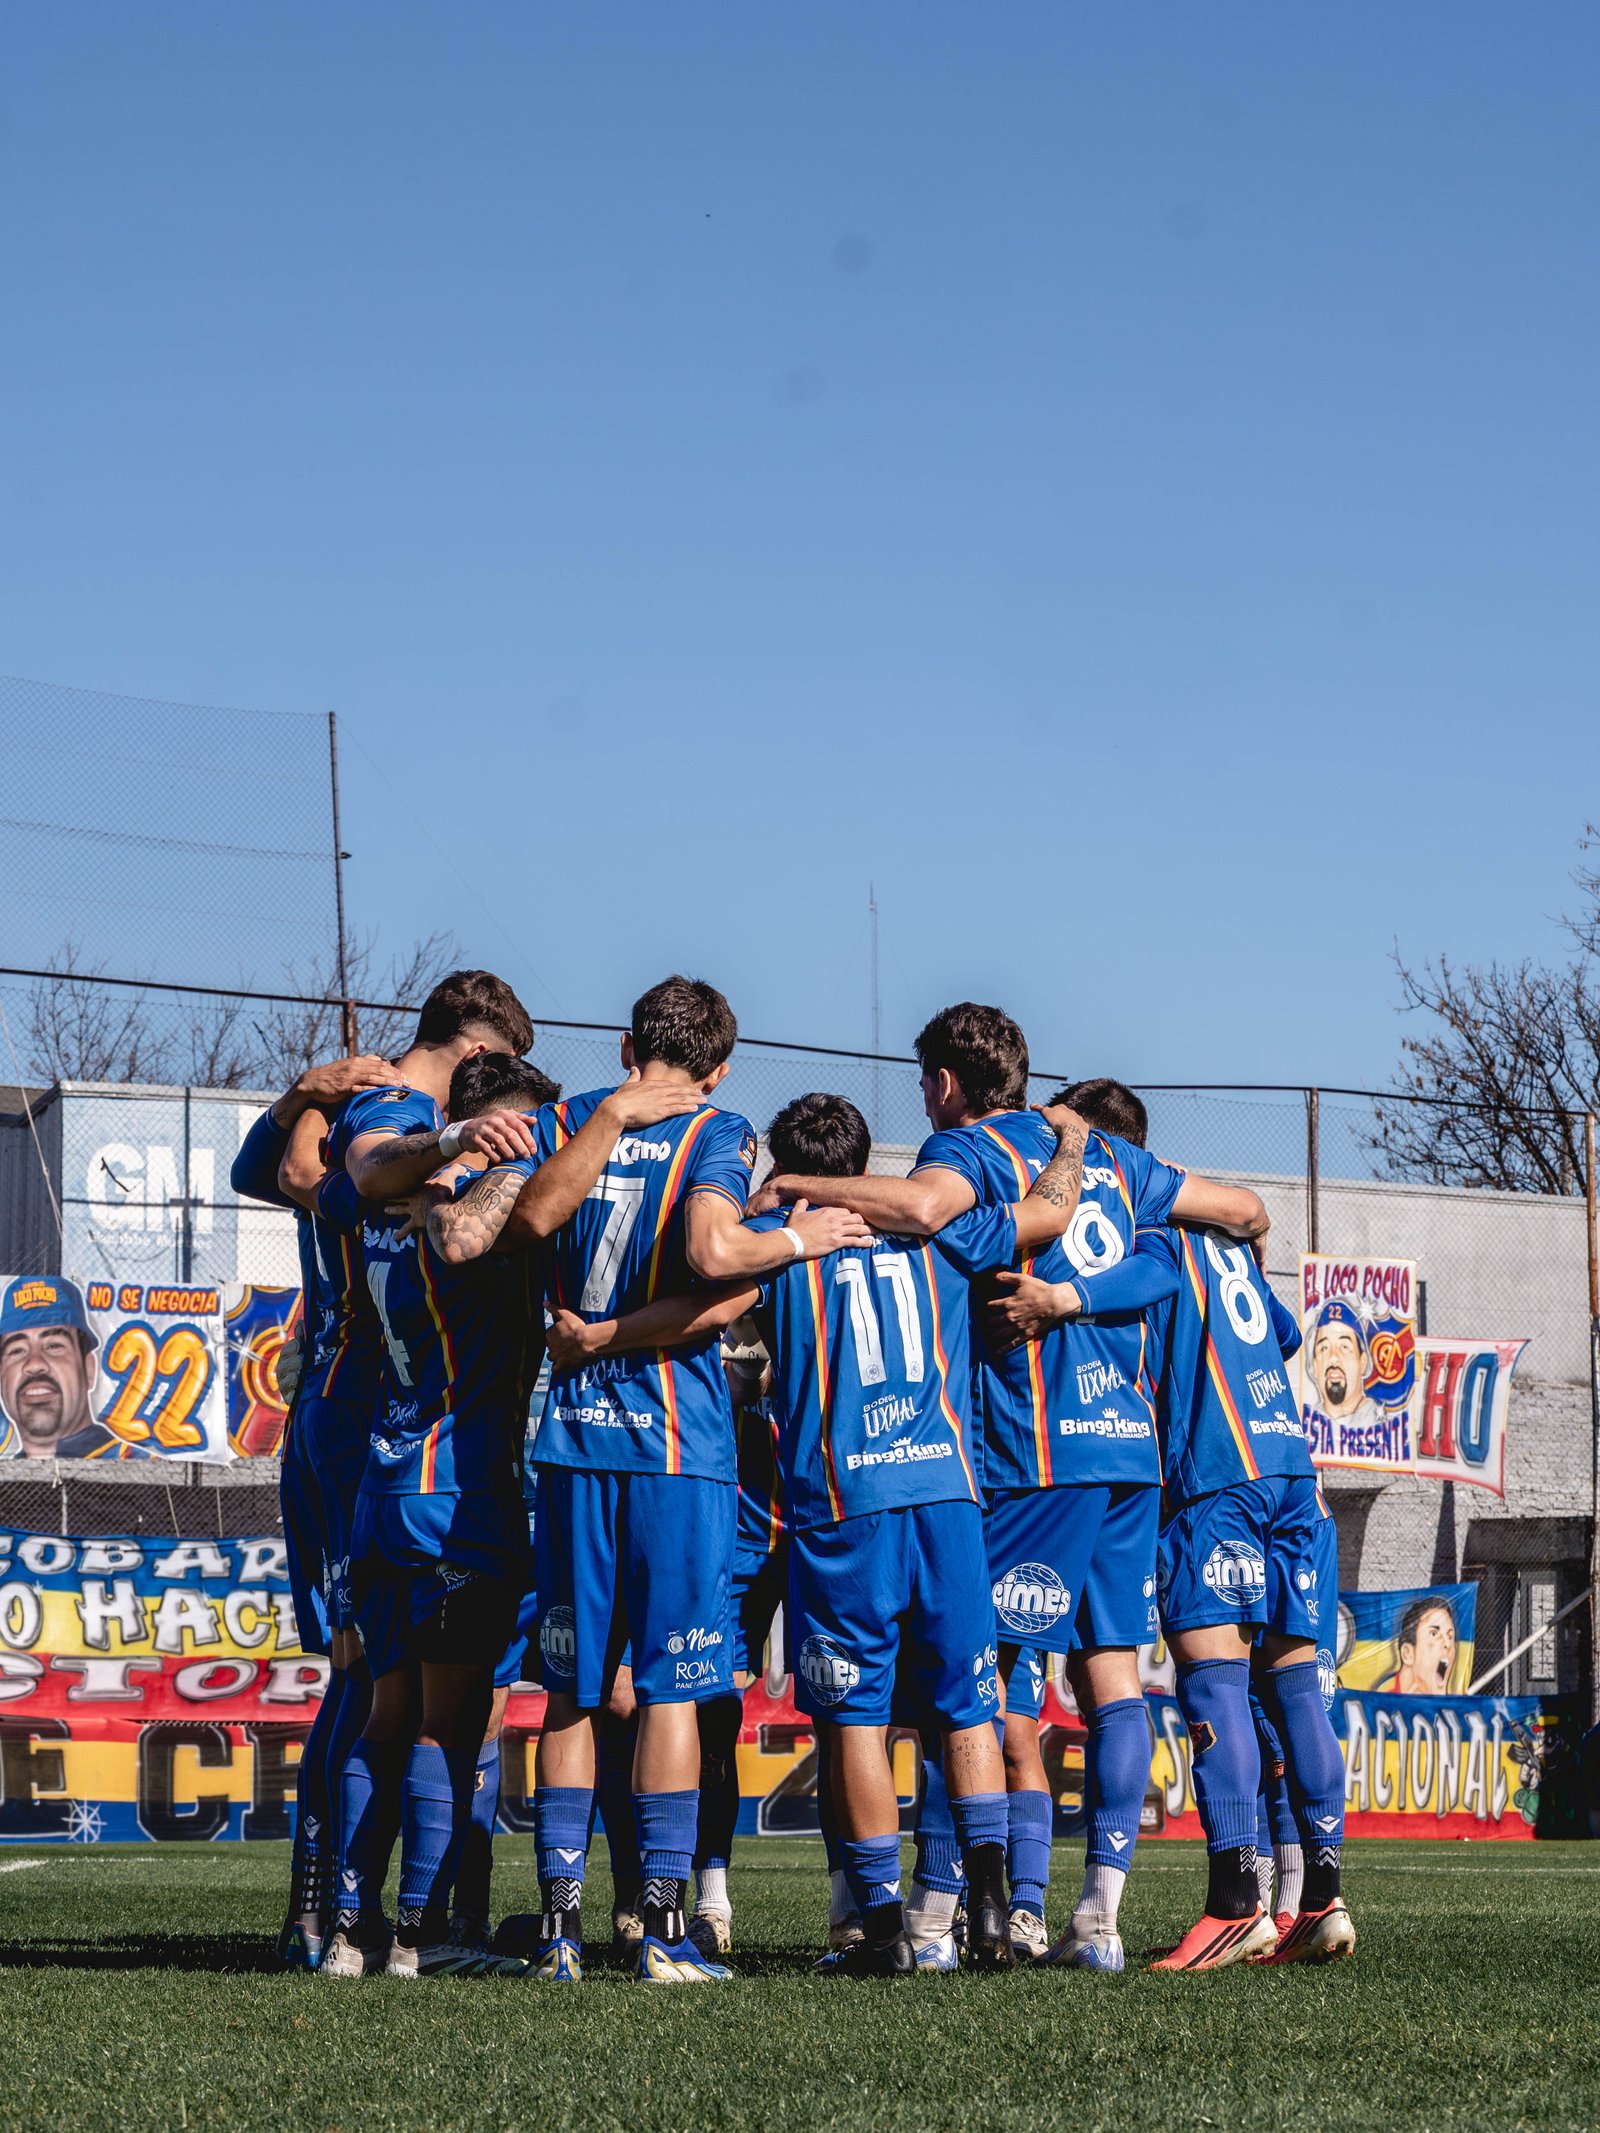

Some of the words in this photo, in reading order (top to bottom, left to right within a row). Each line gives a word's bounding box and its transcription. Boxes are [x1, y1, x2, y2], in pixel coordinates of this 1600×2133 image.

[86, 1143, 214, 1234] GM
[580, 1174, 646, 1313] 7
[88, 1284, 114, 1309] NO
[118, 1286, 142, 1311] SE
[146, 1288, 219, 1314] NEGOCIA
[1204, 1230, 1268, 1345] 8
[1304, 1262, 1320, 1313] EL
[1324, 1264, 1358, 1299] LOCO
[1362, 1265, 1410, 1313] POCHO
[835, 1252, 925, 1387] 11
[1328, 1305, 1342, 1320] 22
[104, 1325, 211, 1450] 22
[863, 1393, 897, 1413] BODEGA
[553, 1406, 606, 1424] Bingo
[862, 1396, 923, 1438] UXMAL
[1059, 1418, 1113, 1436] Bingo
[1114, 1418, 1151, 1437] King
[1249, 1419, 1287, 1435] Bingo
[1415, 1352, 1499, 1467] HO
[846, 1447, 905, 1471] Bingo
[906, 1443, 953, 1459] King
[1340, 1411, 1411, 1462] PRESENTE
[992, 1573, 1072, 1616] cimes
